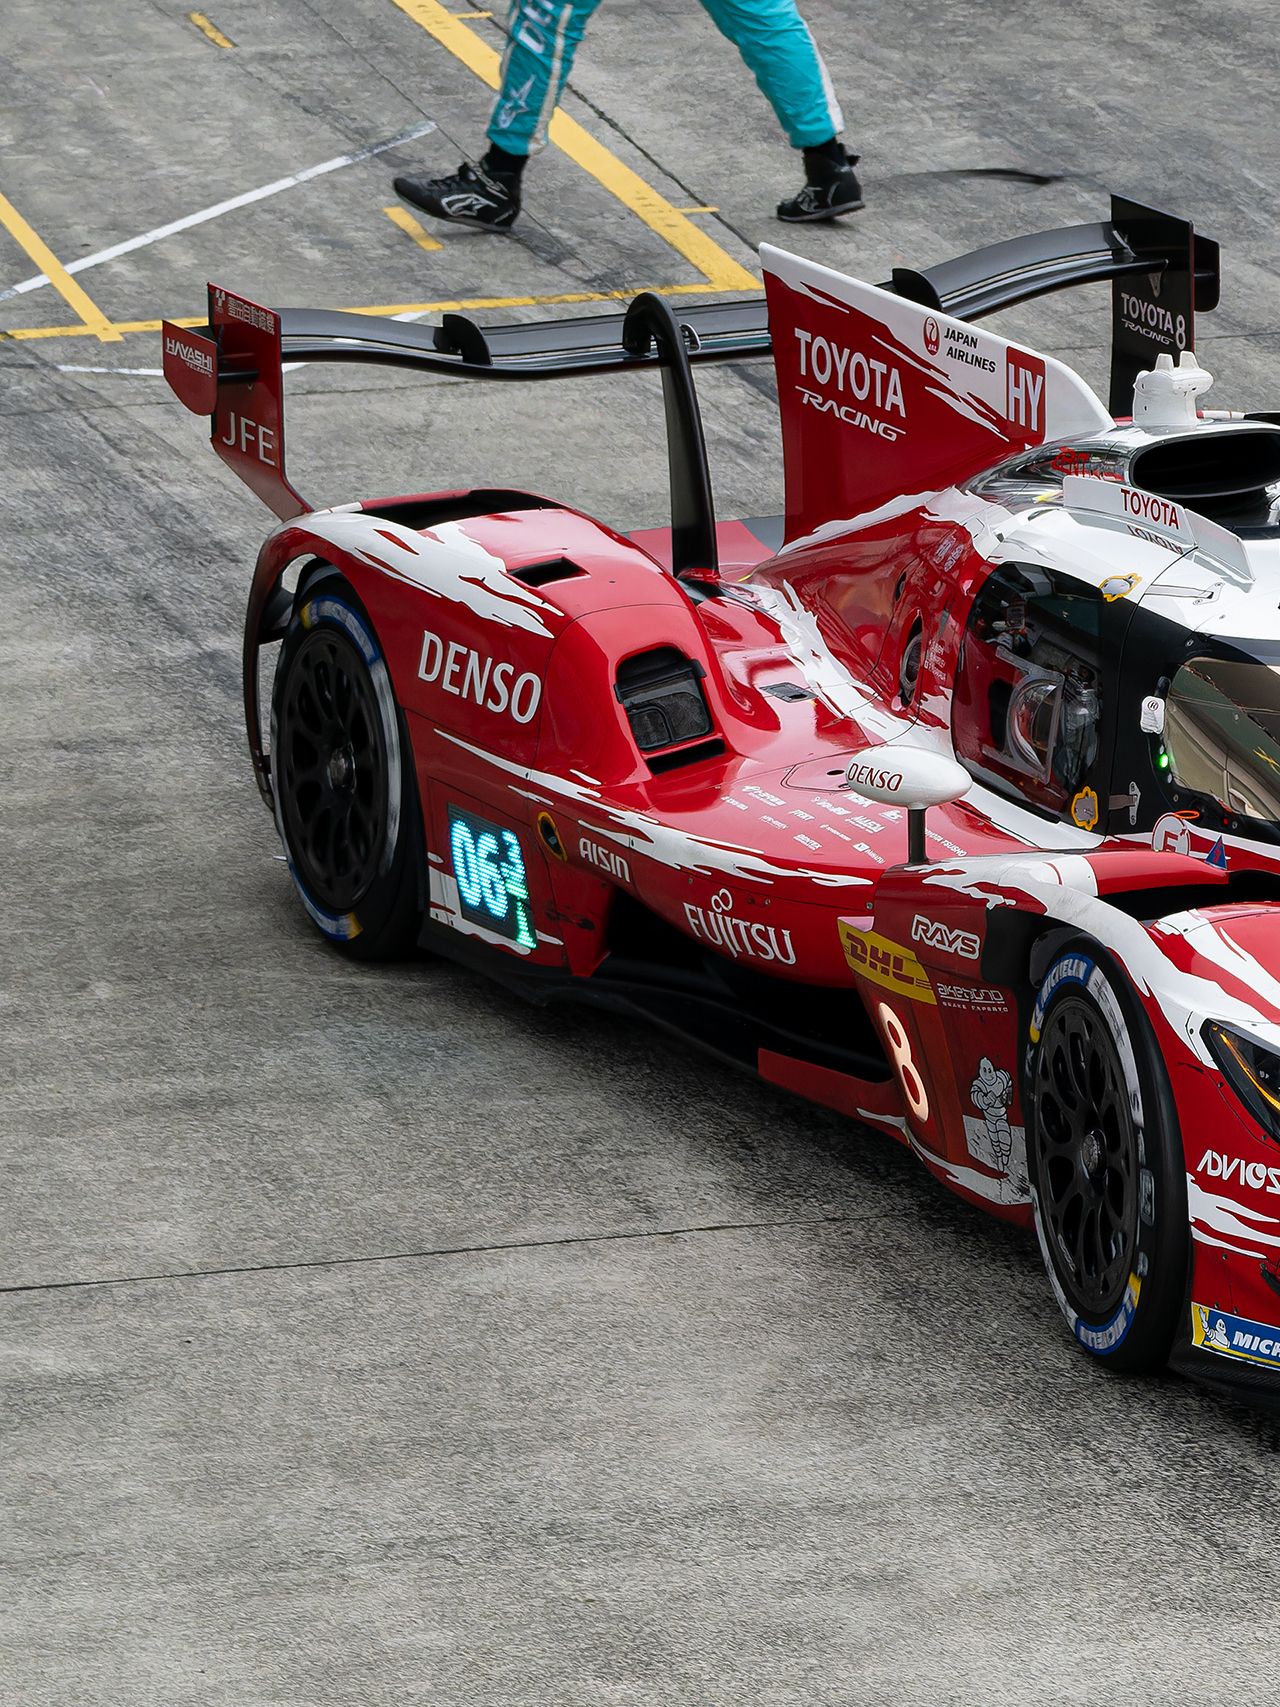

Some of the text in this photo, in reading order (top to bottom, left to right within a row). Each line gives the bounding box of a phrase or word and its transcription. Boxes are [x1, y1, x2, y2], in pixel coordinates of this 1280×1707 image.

[944, 327, 978, 349] JAPAN
[1121, 291, 1186, 350] TOYOTA 8
[1121, 318, 1174, 345] RACING
[166, 337, 213, 371] HAYASHI
[794, 327, 906, 418] TOYOTA
[946, 346, 996, 373] AIRLINES
[795, 385, 906, 441] RACING
[1007, 362, 1044, 432] HY
[222, 411, 275, 466] JFE
[1120, 487, 1180, 530] TOYOTA
[417, 629, 542, 724] DENSO
[847, 763, 903, 792] DENSO
[577, 836, 631, 883] AISIN
[683, 890, 796, 966] FUJITSU
[911, 914, 980, 960] RAYS
[845, 931, 916, 986] DHL
[878, 1002, 929, 1124] 8
